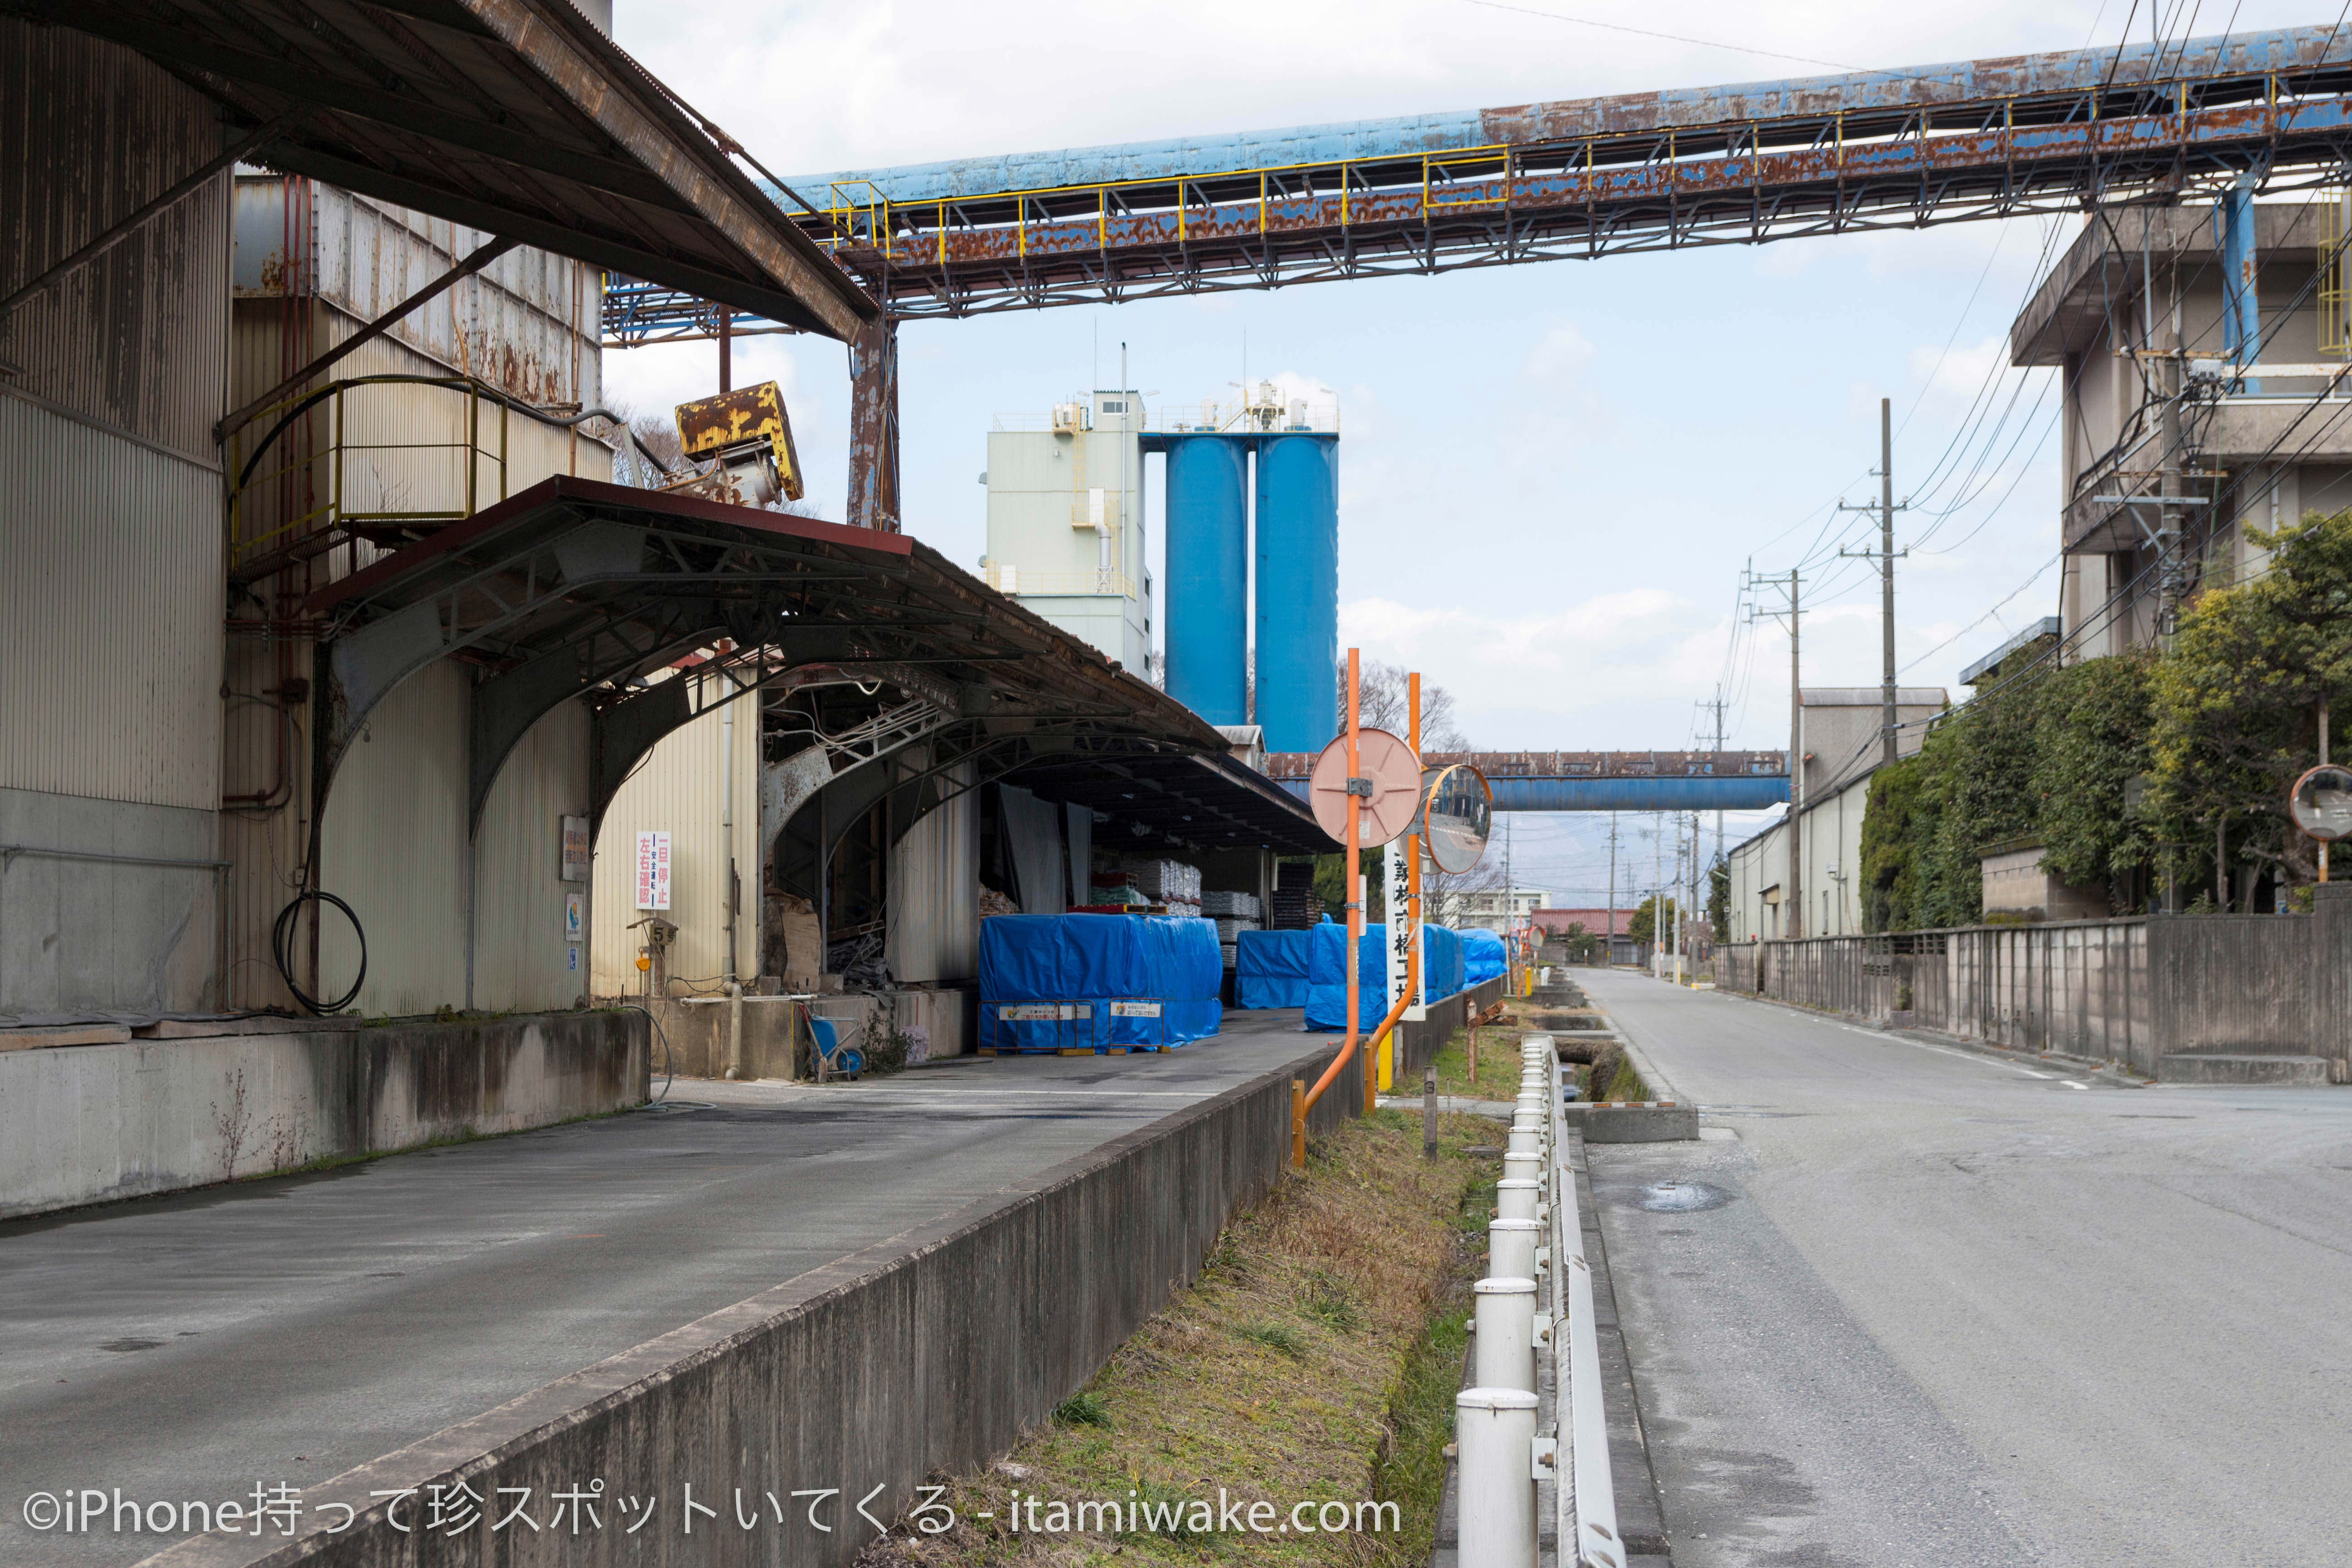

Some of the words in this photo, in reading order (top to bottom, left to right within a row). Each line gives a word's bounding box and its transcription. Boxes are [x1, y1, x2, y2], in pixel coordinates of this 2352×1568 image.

[639, 838, 650, 904] 左右確認
[658, 839, 668, 904] 一旦停止
